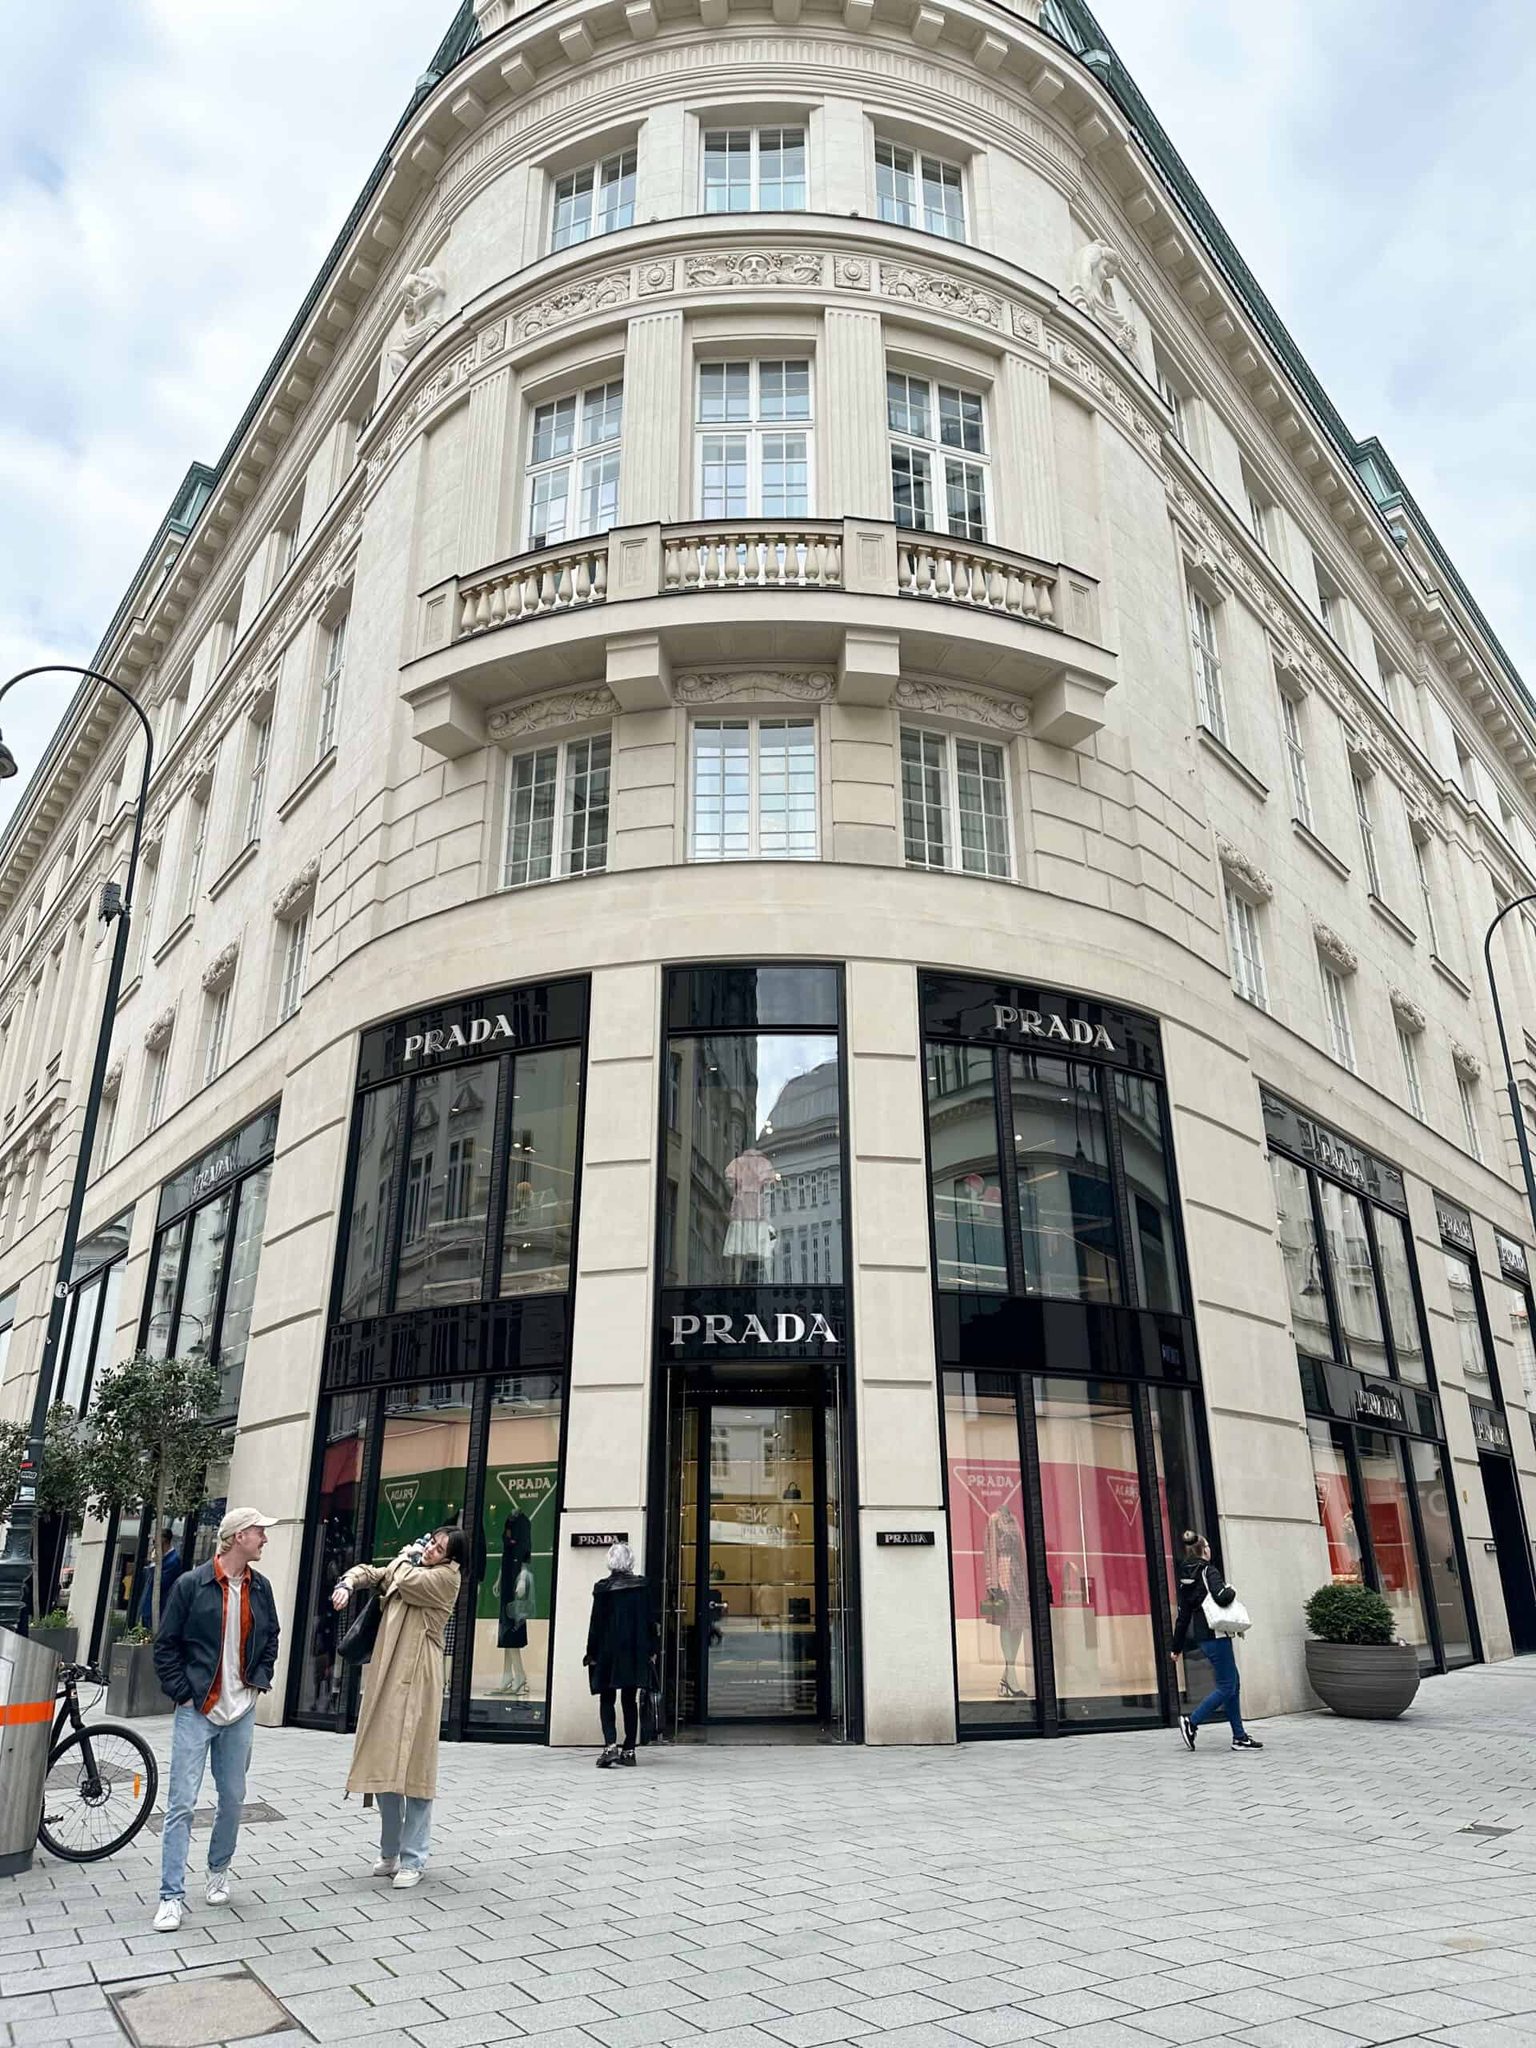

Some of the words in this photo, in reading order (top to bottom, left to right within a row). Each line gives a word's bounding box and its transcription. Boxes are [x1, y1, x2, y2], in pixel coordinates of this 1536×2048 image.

[403, 1014, 516, 1061] PRADA
[992, 1004, 1116, 1052] PRADA
[192, 1155, 232, 1196] PRADA
[1319, 1141, 1365, 1182] PRADA
[670, 1313, 839, 1345] PRADA
[508, 1476, 551, 1490] PRADA
[967, 1474, 1014, 1488] PRADA
[579, 1535, 620, 1544] PRADA
[884, 1533, 928, 1543] PRADA
